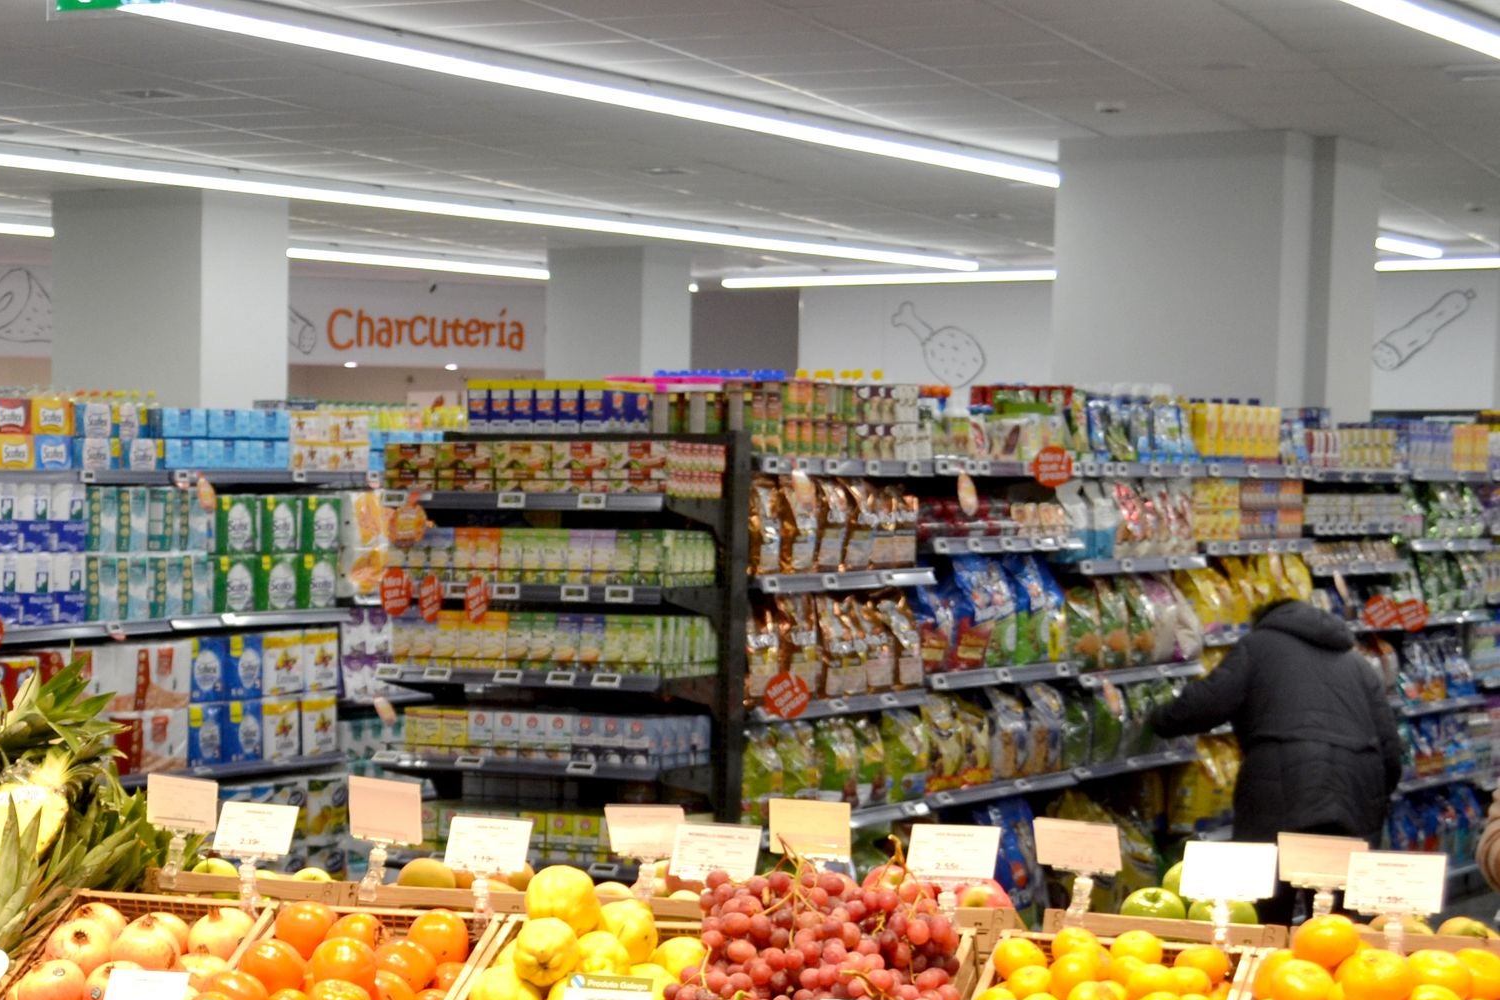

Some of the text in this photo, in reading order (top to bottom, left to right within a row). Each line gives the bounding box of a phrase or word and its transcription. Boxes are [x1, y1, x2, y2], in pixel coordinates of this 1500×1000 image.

[327, 306, 525, 351] Charcutería
[587, 979, 649, 990] Produto Galego
